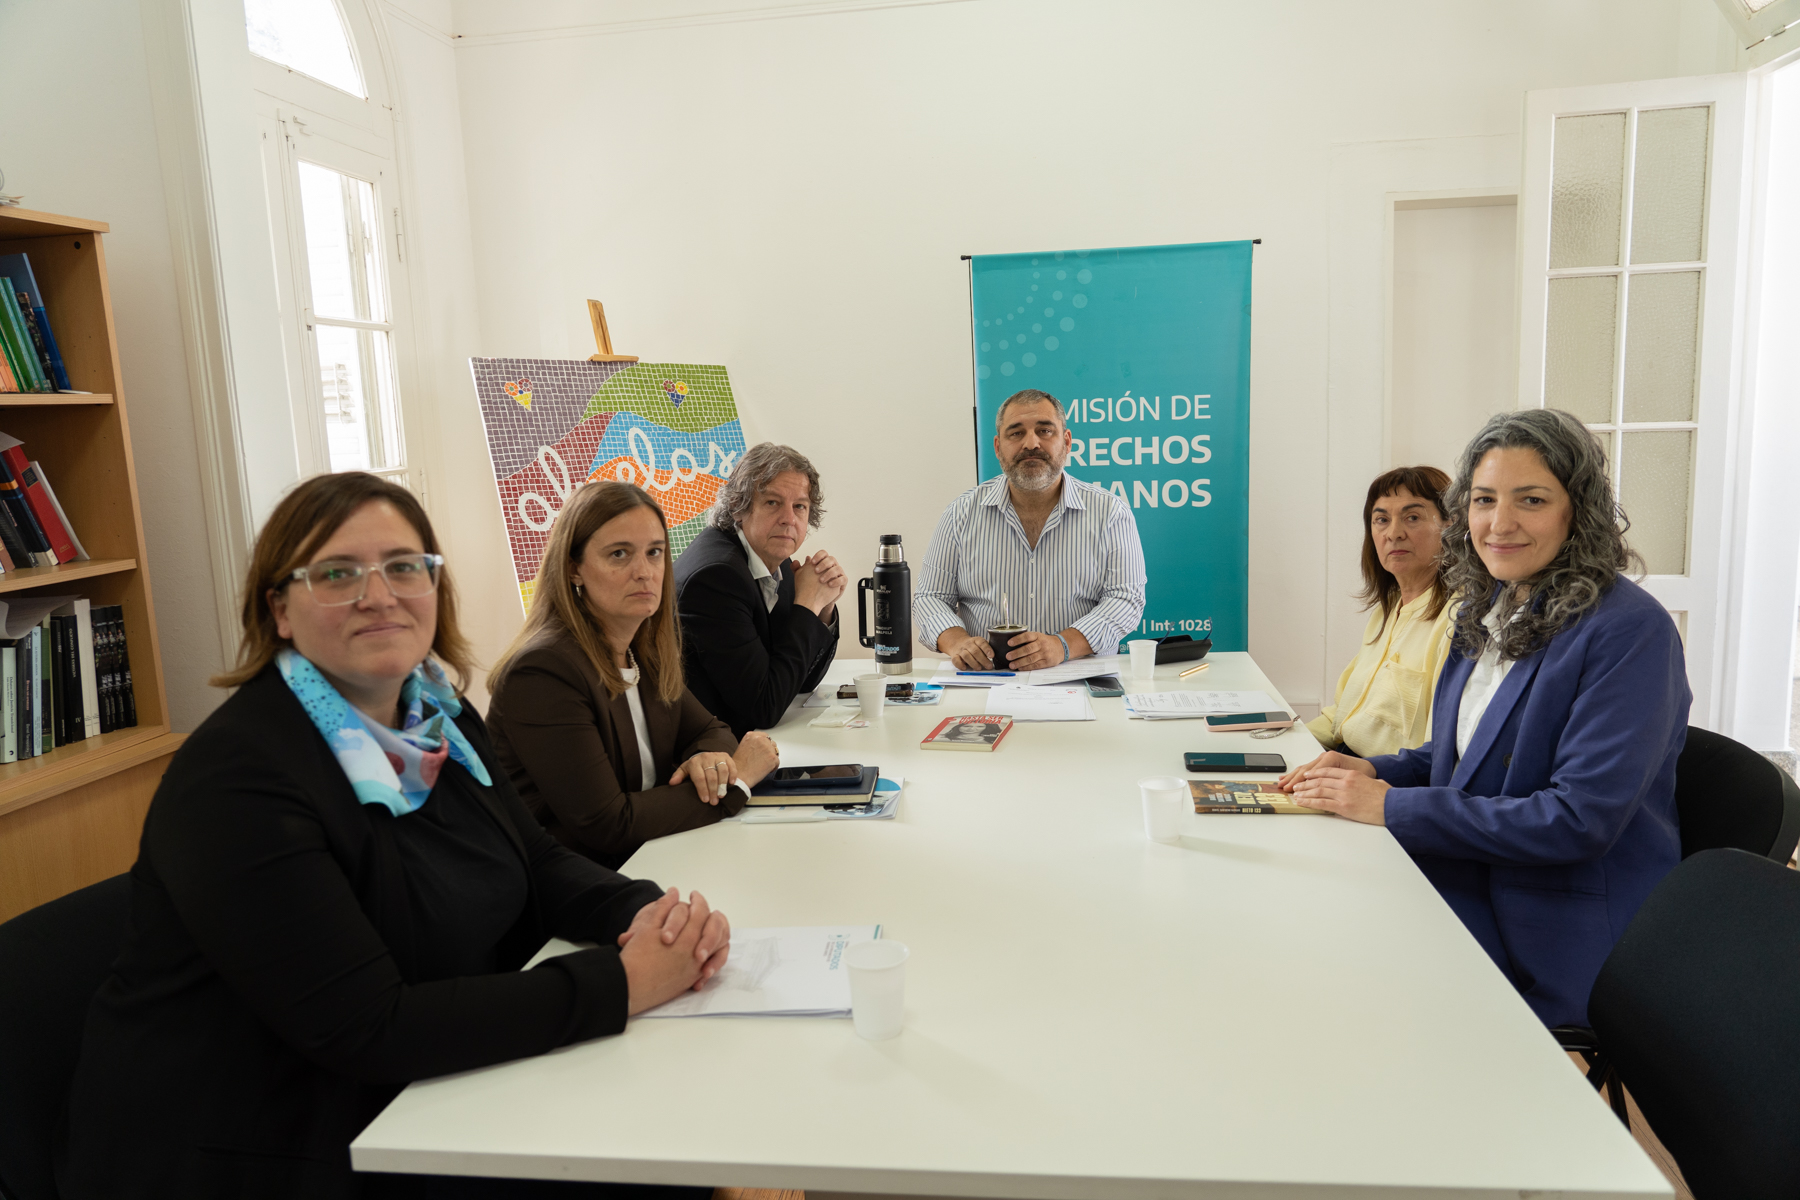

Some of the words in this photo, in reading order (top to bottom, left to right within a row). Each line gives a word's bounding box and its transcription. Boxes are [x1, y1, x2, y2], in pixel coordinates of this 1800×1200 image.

[1065, 391, 1160, 423] MISIÓN
[1171, 394, 1211, 421] DE
[1065, 434, 1212, 467] RECHOS
[1092, 478, 1212, 509] ANOS
[1151, 619, 1175, 631] Int.
[1178, 619, 1212, 631] 1028
